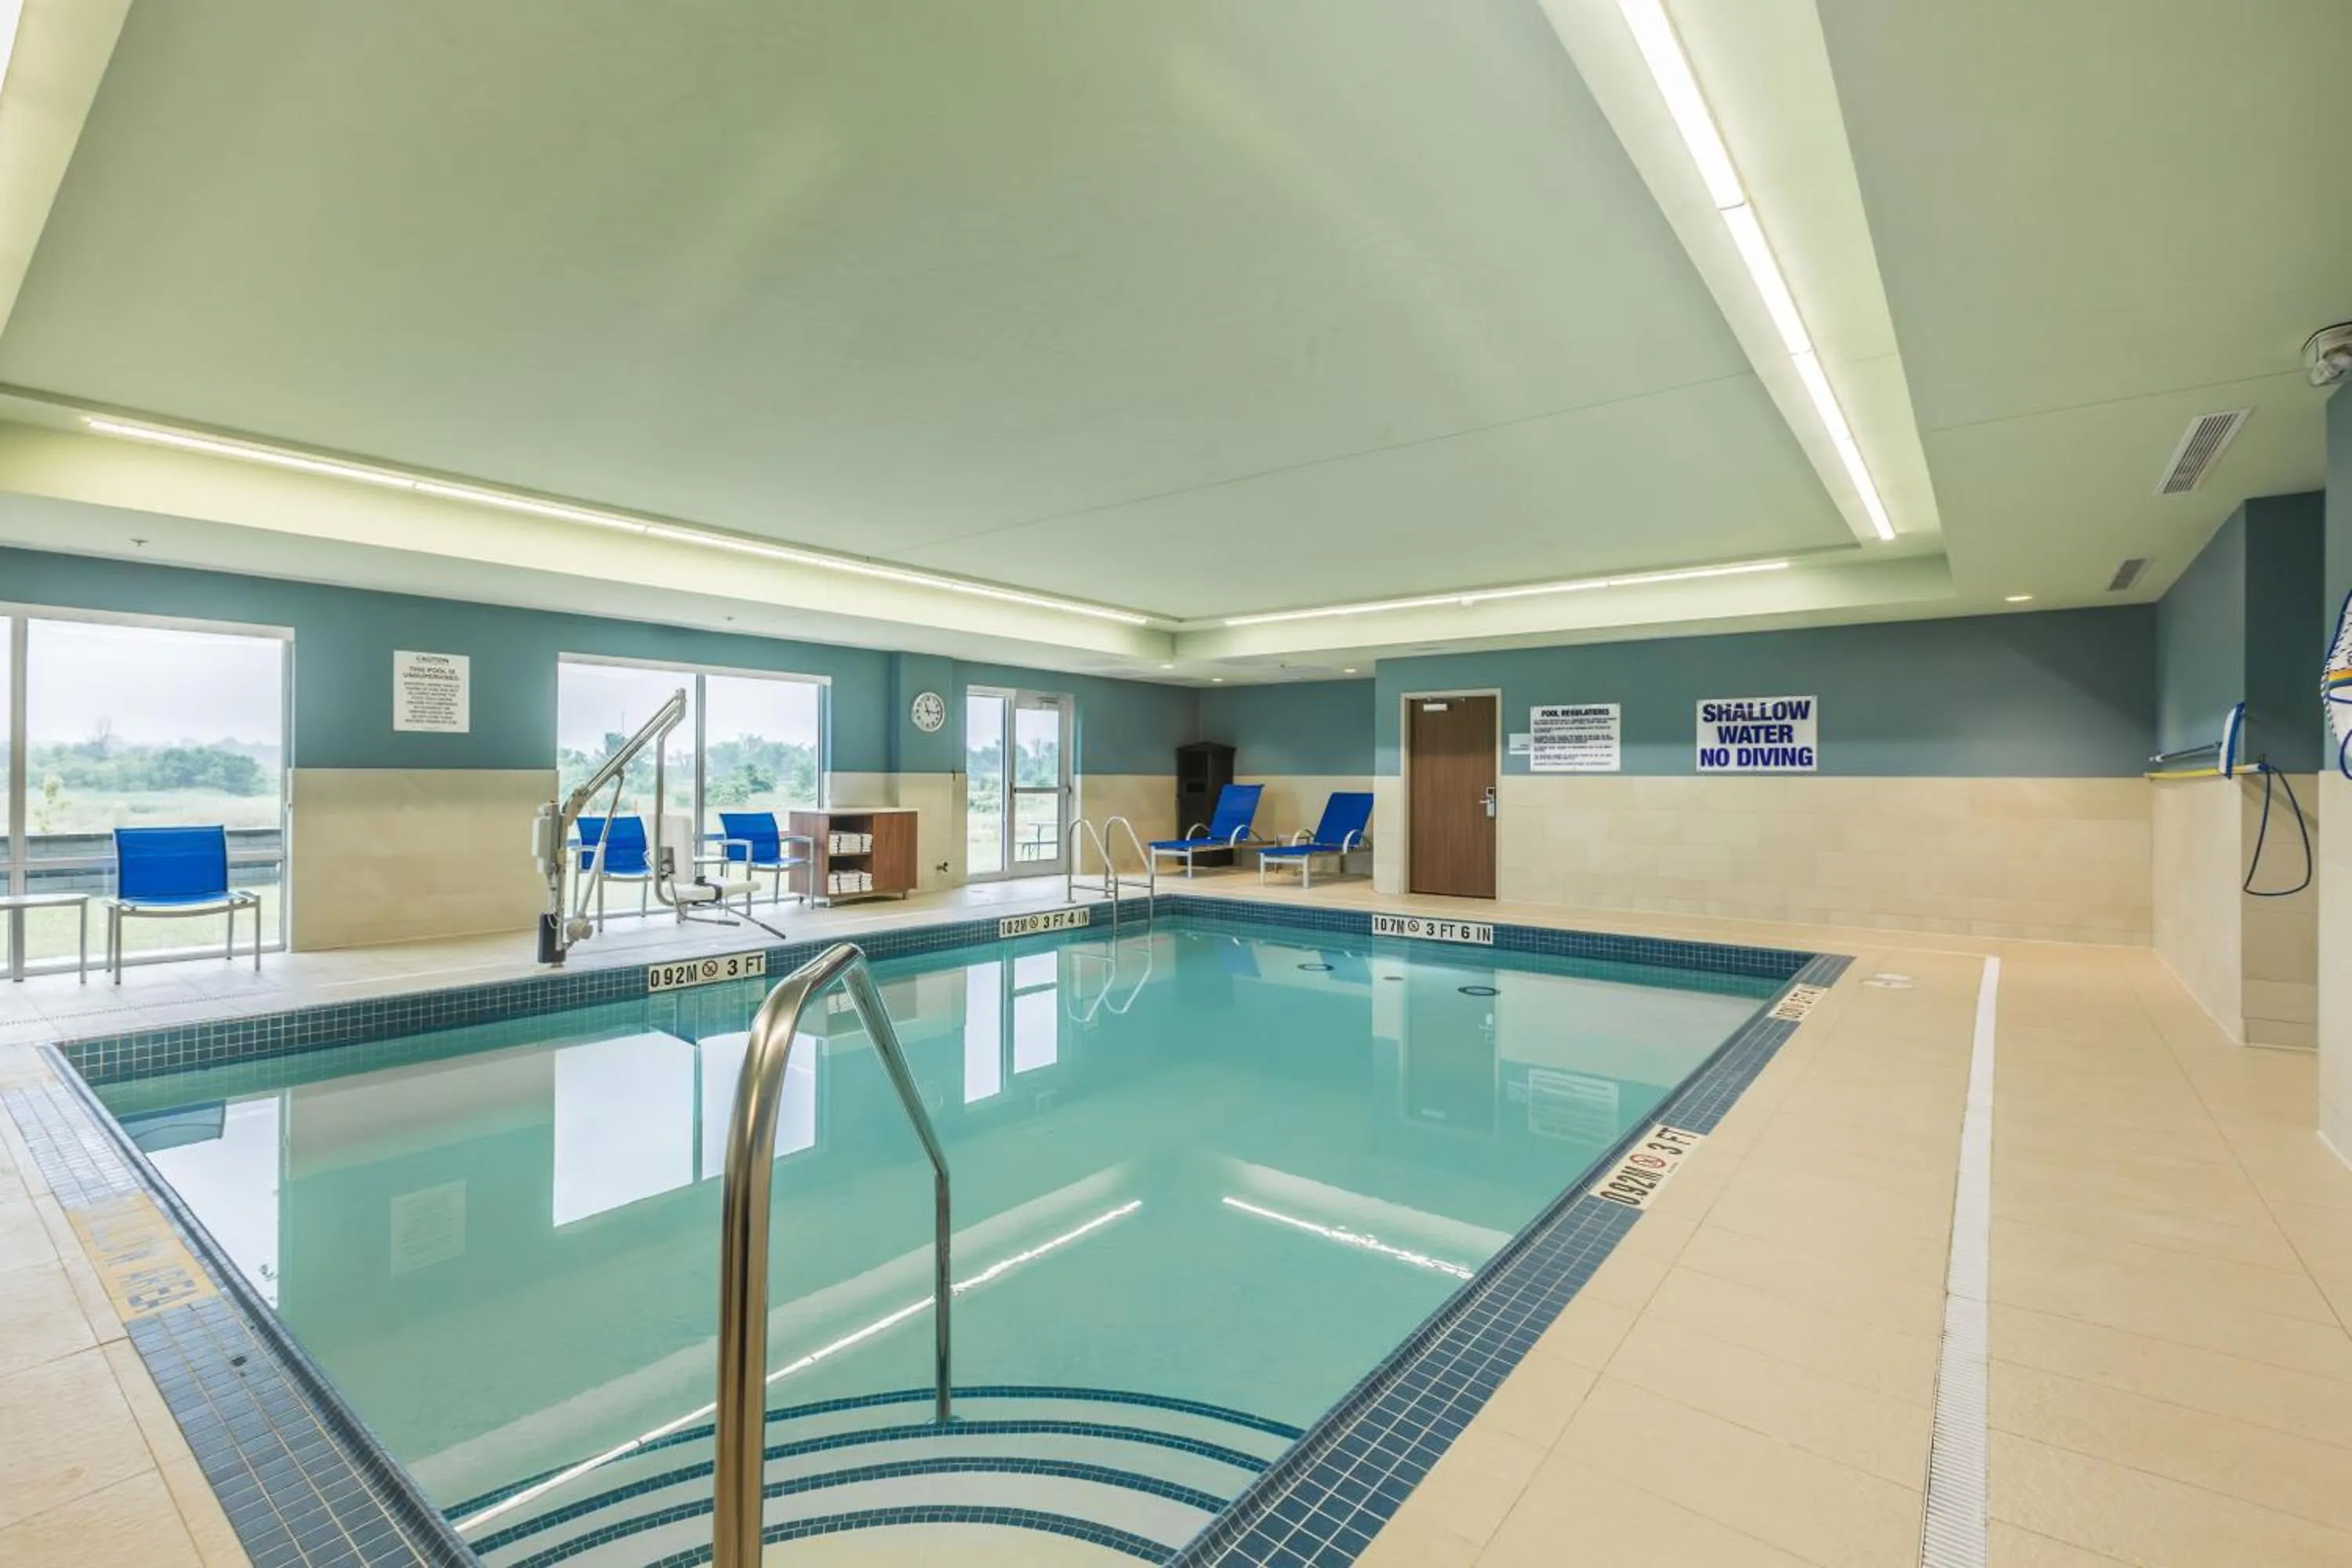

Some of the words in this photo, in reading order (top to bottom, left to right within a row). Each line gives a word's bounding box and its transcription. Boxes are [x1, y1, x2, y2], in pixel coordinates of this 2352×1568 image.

[1561, 708, 1610, 717] REGULATIONS
[1702, 700, 1811, 723] SHALLOW
[1717, 724, 1793, 744] WATER
[1700, 747, 1730, 767] NO
[1737, 746, 1813, 767] DIVING
[1044, 915, 1050, 928] 3
[1053, 913, 1065, 927] FT
[1068, 912, 1075, 924] 4
[1426, 923, 1435, 936] 3
[1440, 924, 1455, 938] FT
[1461, 926, 1470, 939] 6
[1476, 927, 1490, 942] IN
[728, 959, 738, 976] 3
[746, 954, 764, 974] FT
[1656, 1127, 1698, 1145] FT
[1646, 1142, 1683, 1155] 3
